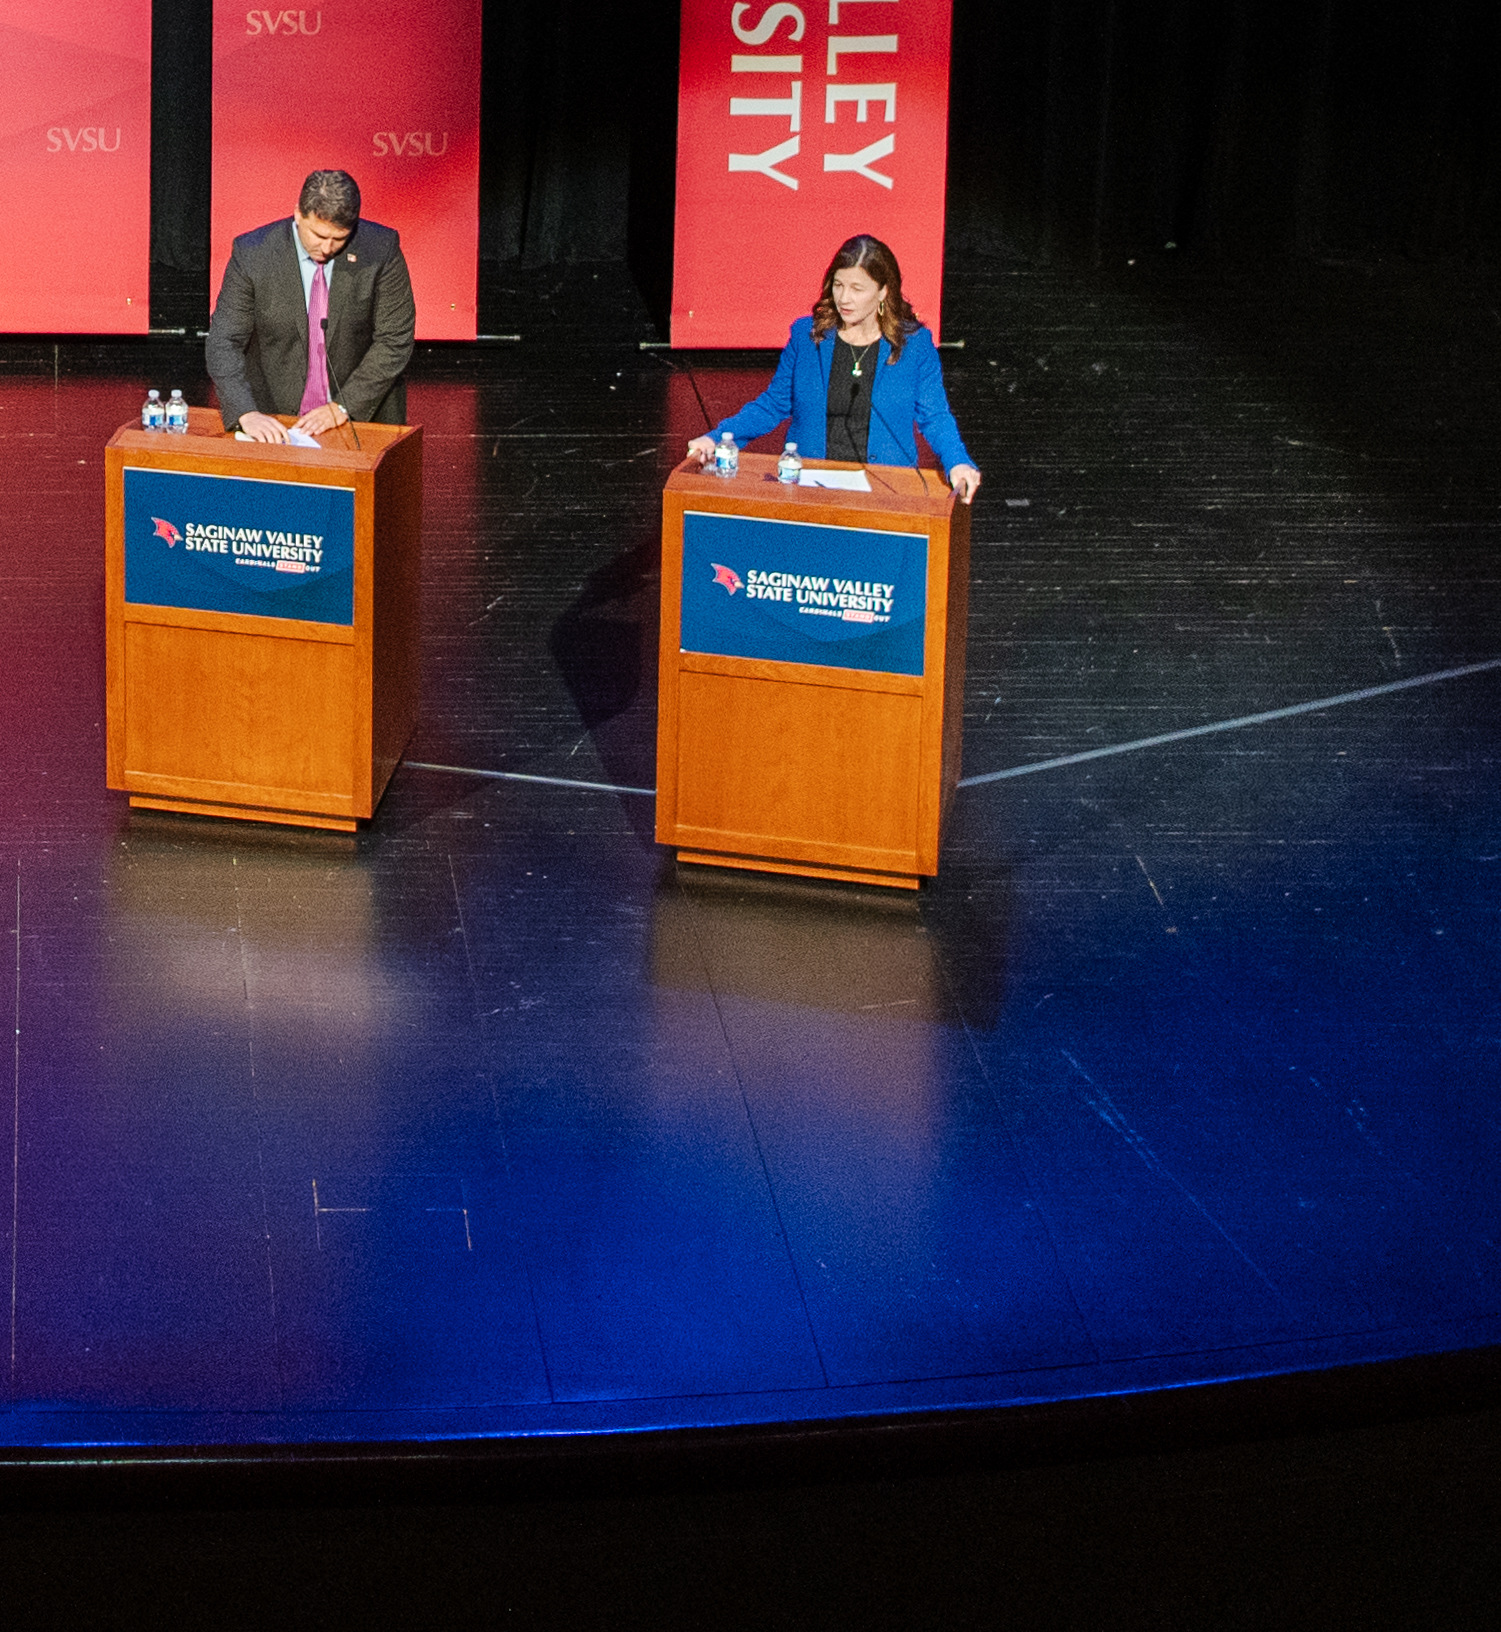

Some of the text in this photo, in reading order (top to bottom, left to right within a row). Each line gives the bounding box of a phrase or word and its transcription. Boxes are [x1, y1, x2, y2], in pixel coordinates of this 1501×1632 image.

[245, 9, 323, 37] SVSU
[46, 127, 122, 154] SVSU
[372, 131, 449, 158] SVSU
[185, 523, 323, 549] SAGINAW VALLEY
[185, 537, 323, 563] STATE UNIVERSITY
[747, 570, 894, 599] SAGINAW VALLEY
[746, 585, 894, 613] STATE UNIVERSITY
